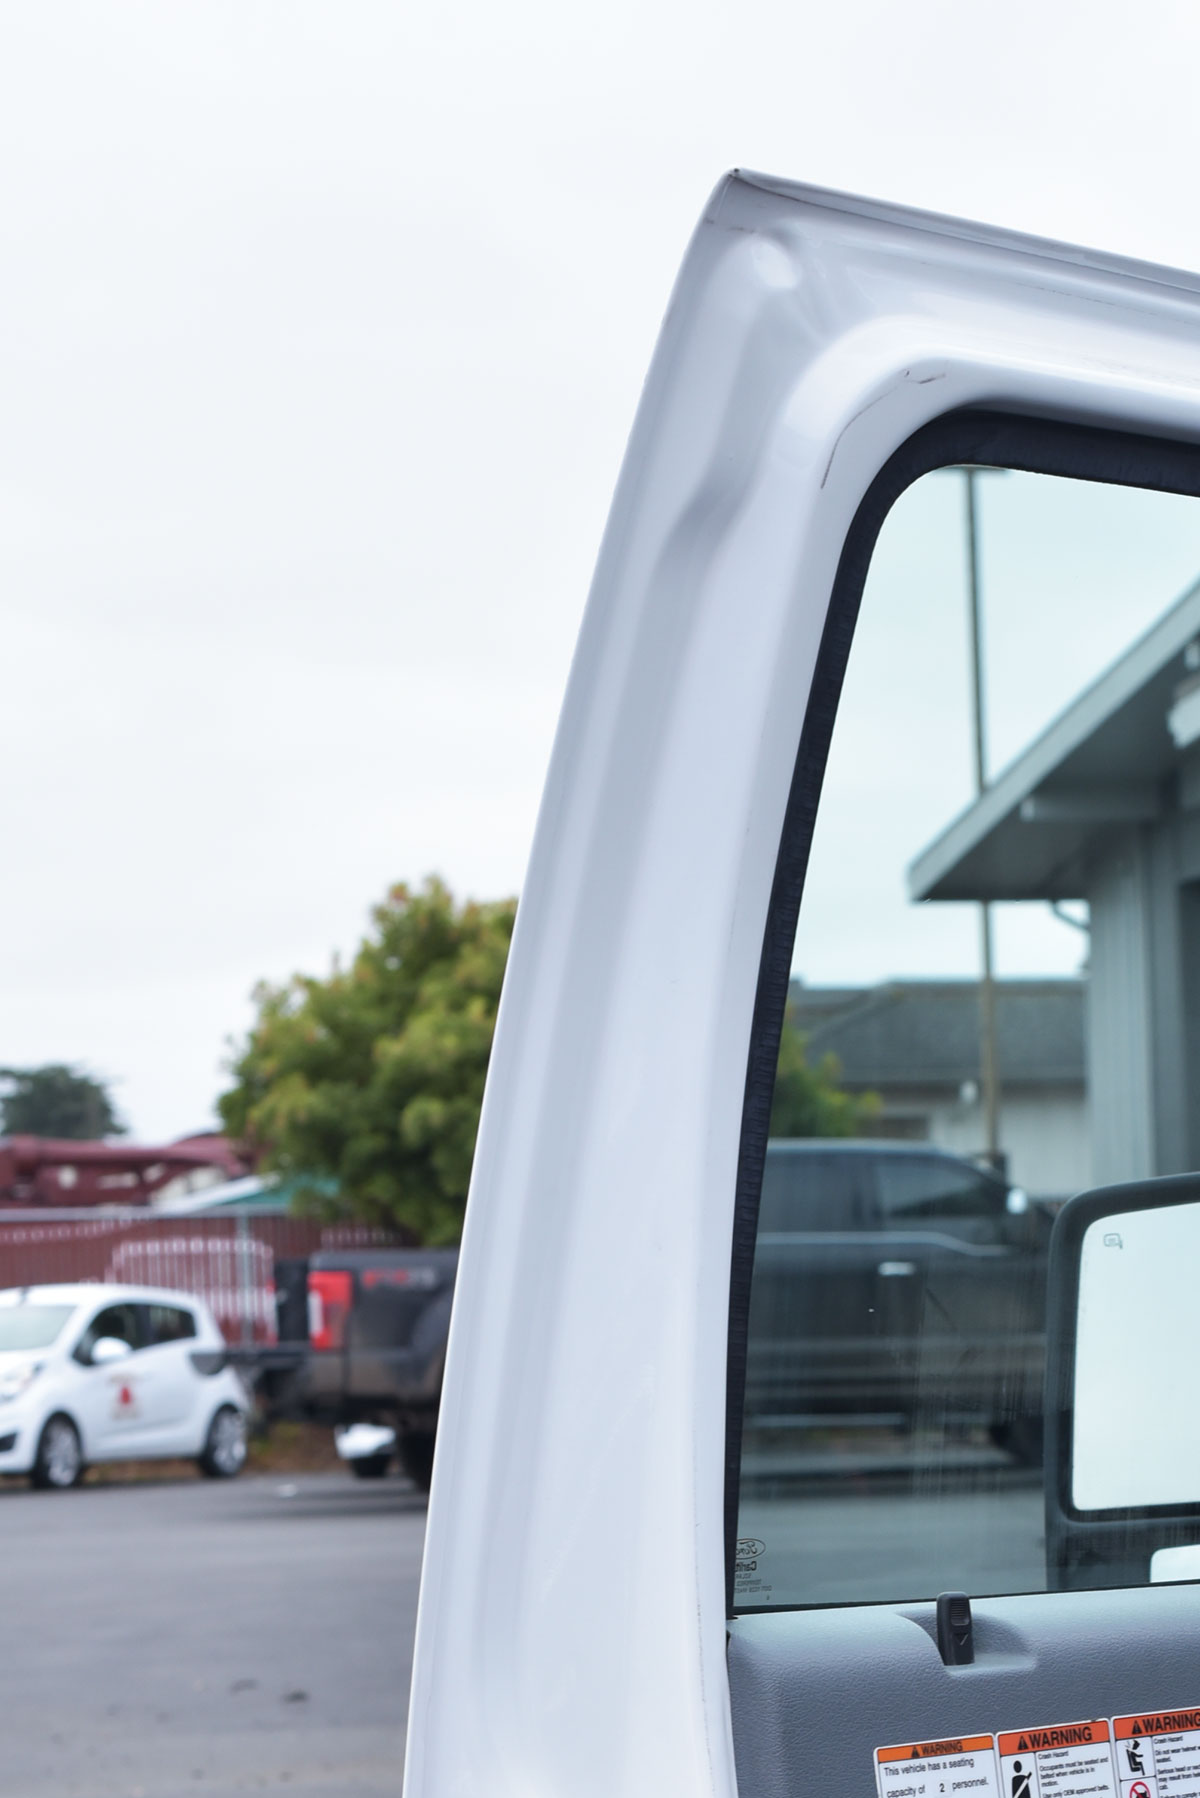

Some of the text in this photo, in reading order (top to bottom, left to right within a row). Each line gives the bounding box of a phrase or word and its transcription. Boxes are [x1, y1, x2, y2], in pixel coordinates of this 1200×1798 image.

[1028, 1726, 1091, 1747] WARNING
[921, 1741, 962, 1754] WARNING
[883, 1757, 974, 1776] This vehicle has a seating
[886, 1776, 988, 1798] capacity of 2 personnel.
